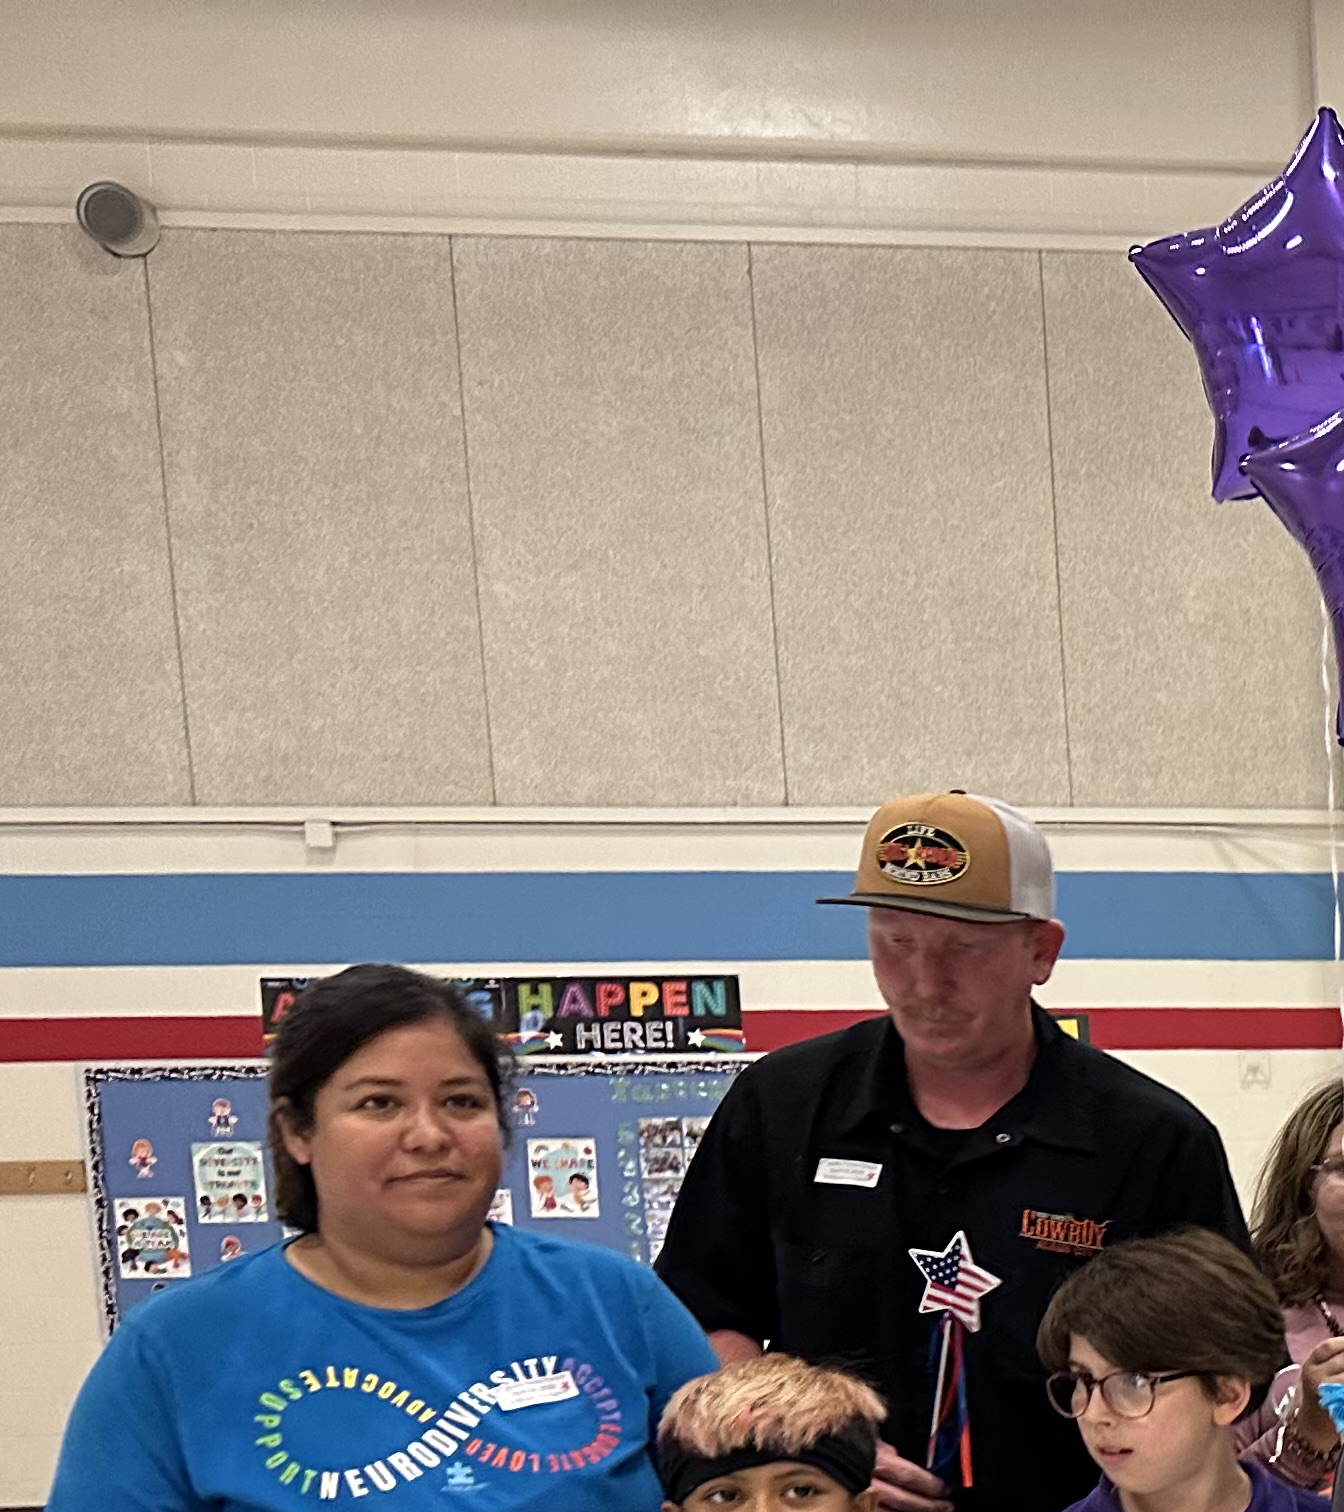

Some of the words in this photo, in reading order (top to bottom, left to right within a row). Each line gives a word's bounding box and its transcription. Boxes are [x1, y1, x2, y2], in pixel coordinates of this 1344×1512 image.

[517, 980, 727, 1019] HAPPEN
[575, 1021, 675, 1049] HERE!
[1021, 1209, 1109, 1248] COWBOY
[300, 1366, 436, 1424] ADVOCATE
[254, 1379, 318, 1495] SUPPORT
[318, 1355, 558, 1501] NEURODIVERSITY
